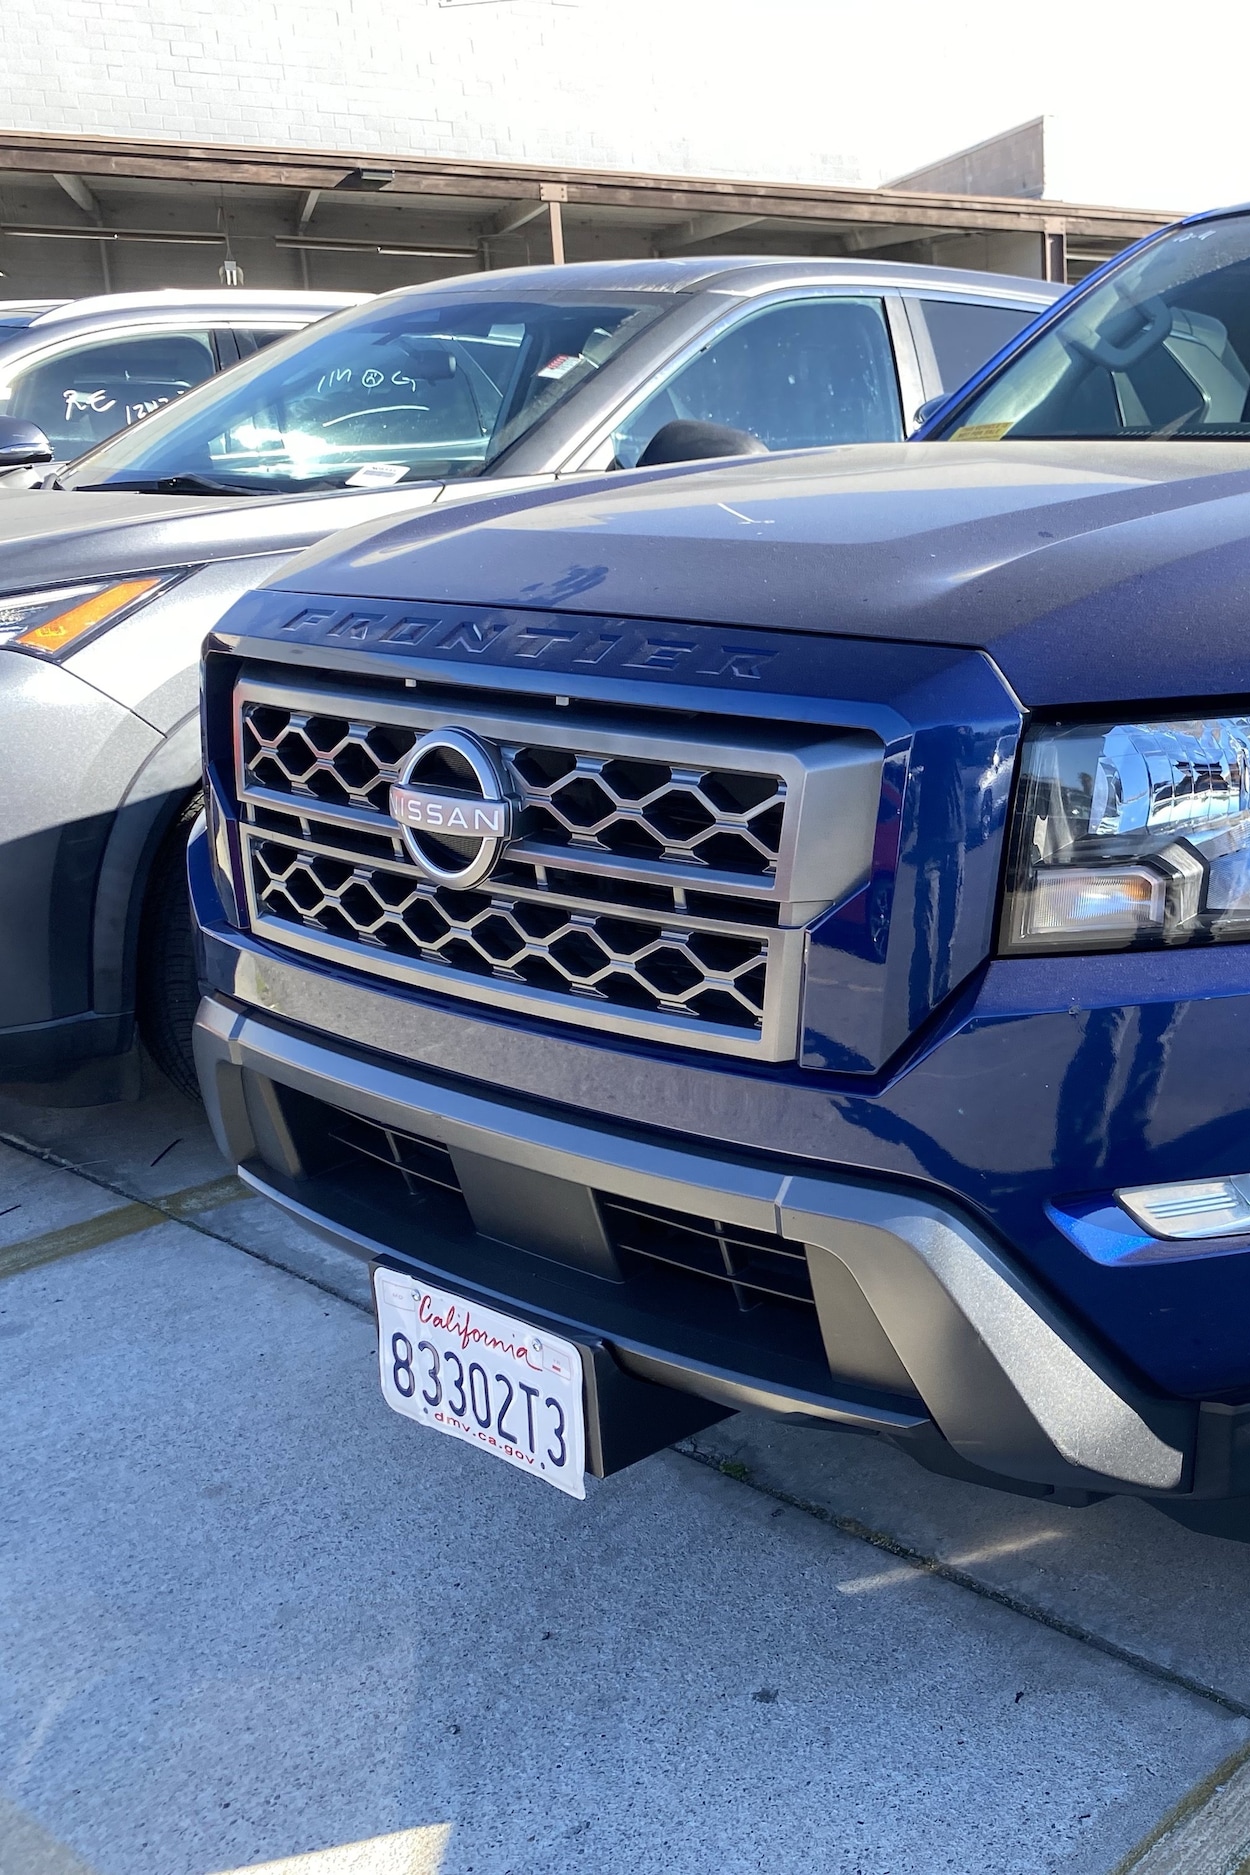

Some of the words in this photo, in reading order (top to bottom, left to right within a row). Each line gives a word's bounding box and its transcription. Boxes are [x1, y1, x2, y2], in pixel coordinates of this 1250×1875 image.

[281, 608, 780, 680] FRONTIER
[389, 790, 499, 832] NISSAN
[418, 1294, 544, 1372] California
[391, 1331, 567, 1468] 83302T3
[434, 1411, 535, 1465] dmv.ca.gov
